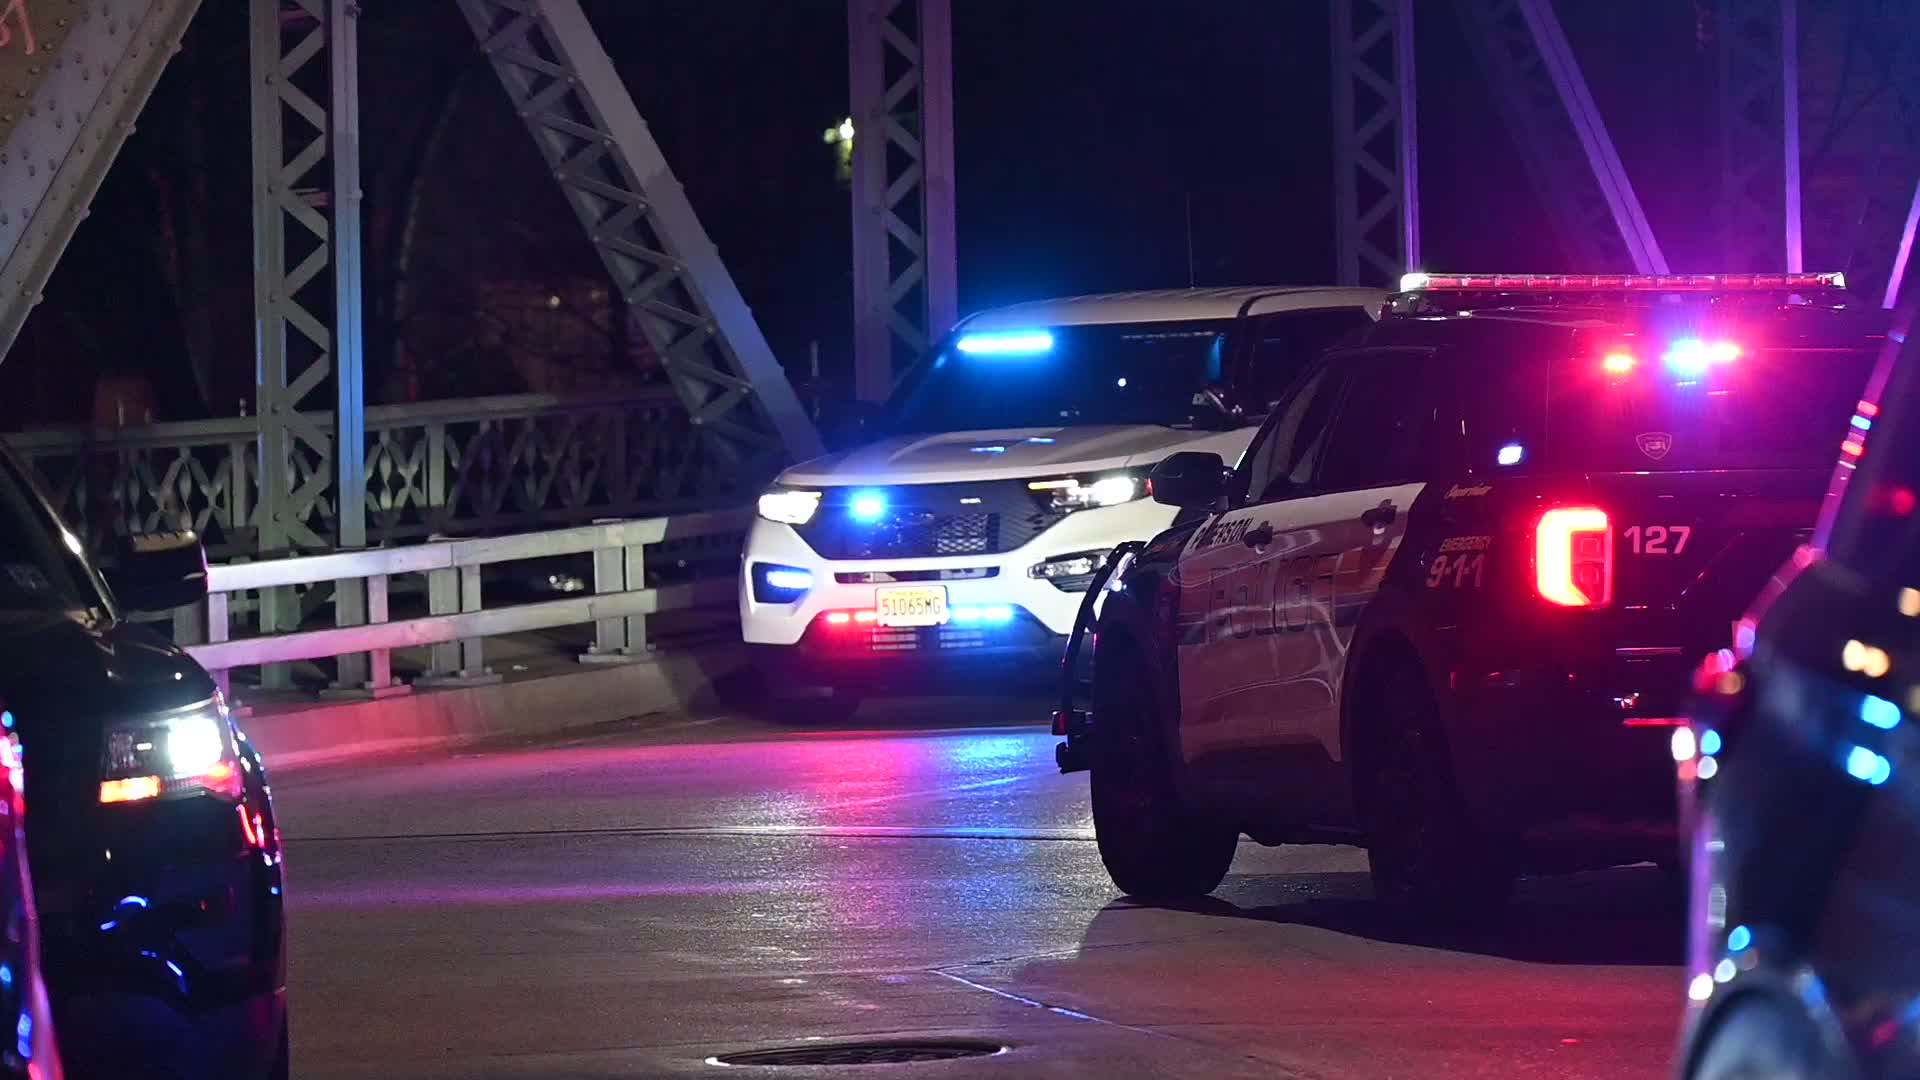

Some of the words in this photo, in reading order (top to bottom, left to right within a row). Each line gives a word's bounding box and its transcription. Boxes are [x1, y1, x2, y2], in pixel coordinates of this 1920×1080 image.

[1623, 525, 1691, 554] 127
[1425, 553, 1486, 589] 9-1-1
[881, 596, 941, 616] 51065MG
